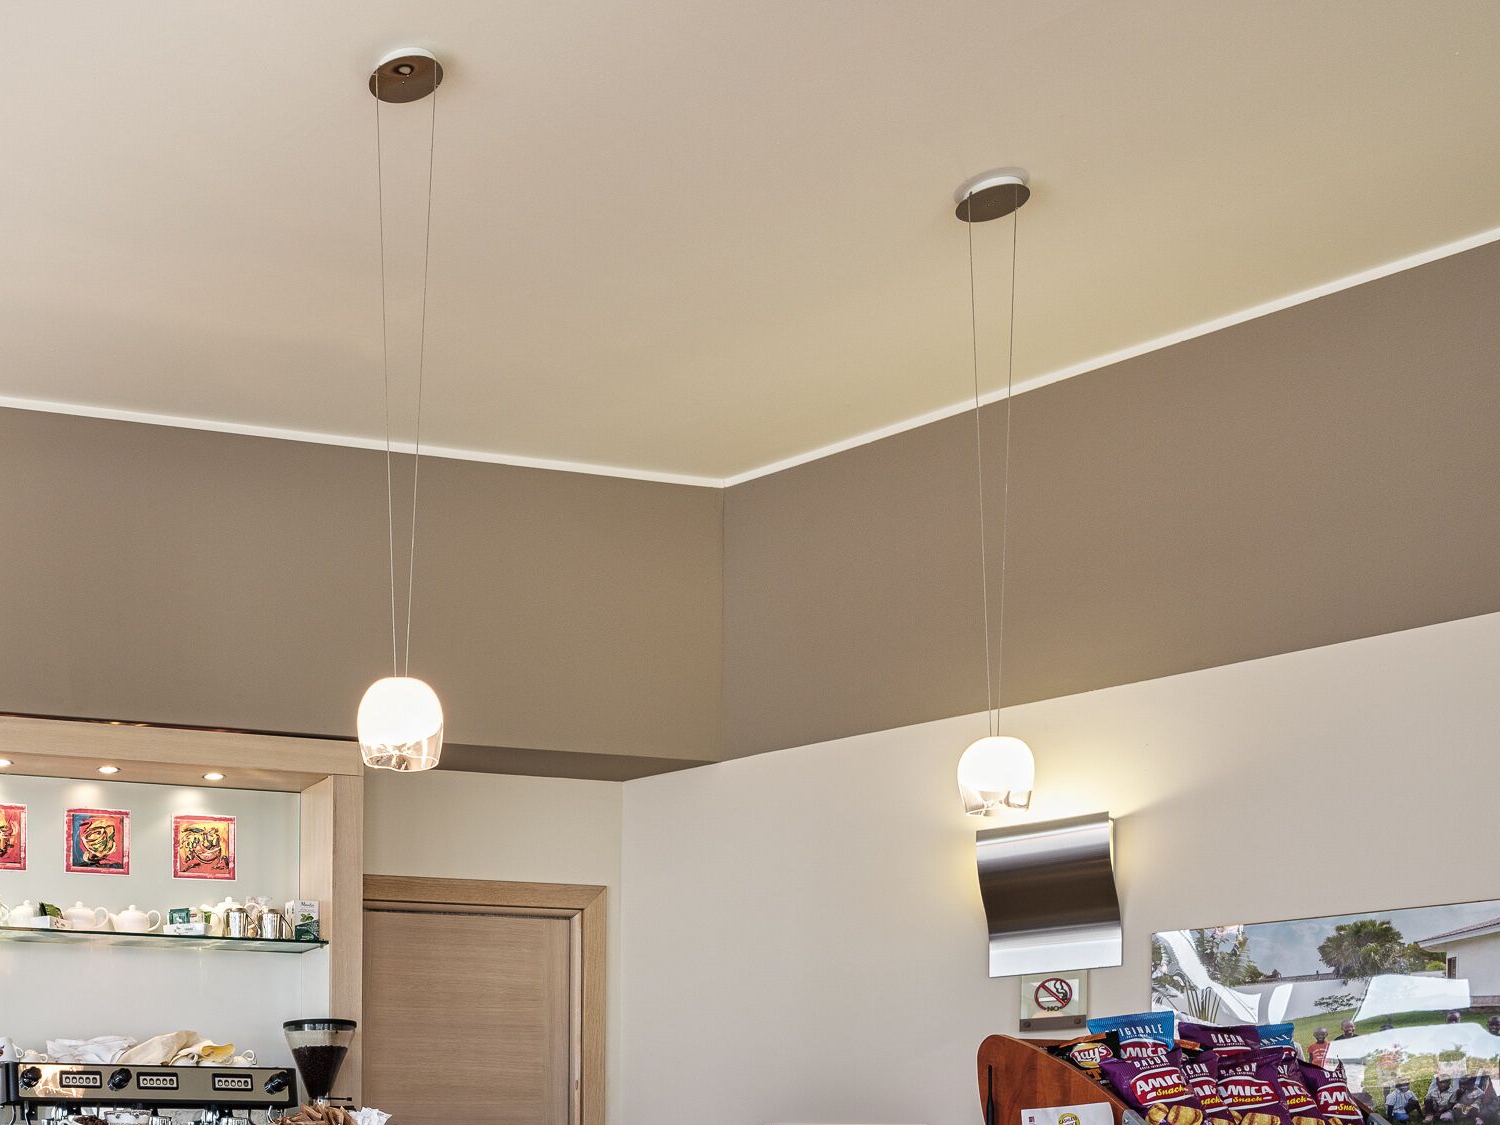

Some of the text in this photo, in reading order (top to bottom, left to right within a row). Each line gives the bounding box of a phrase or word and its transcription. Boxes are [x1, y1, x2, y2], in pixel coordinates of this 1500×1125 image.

[1105, 1024, 1164, 1037] IGINALE
[1210, 1033, 1245, 1044] BACON
[1220, 1062, 1257, 1075] BACON
[1218, 1084, 1275, 1098] AMICA
